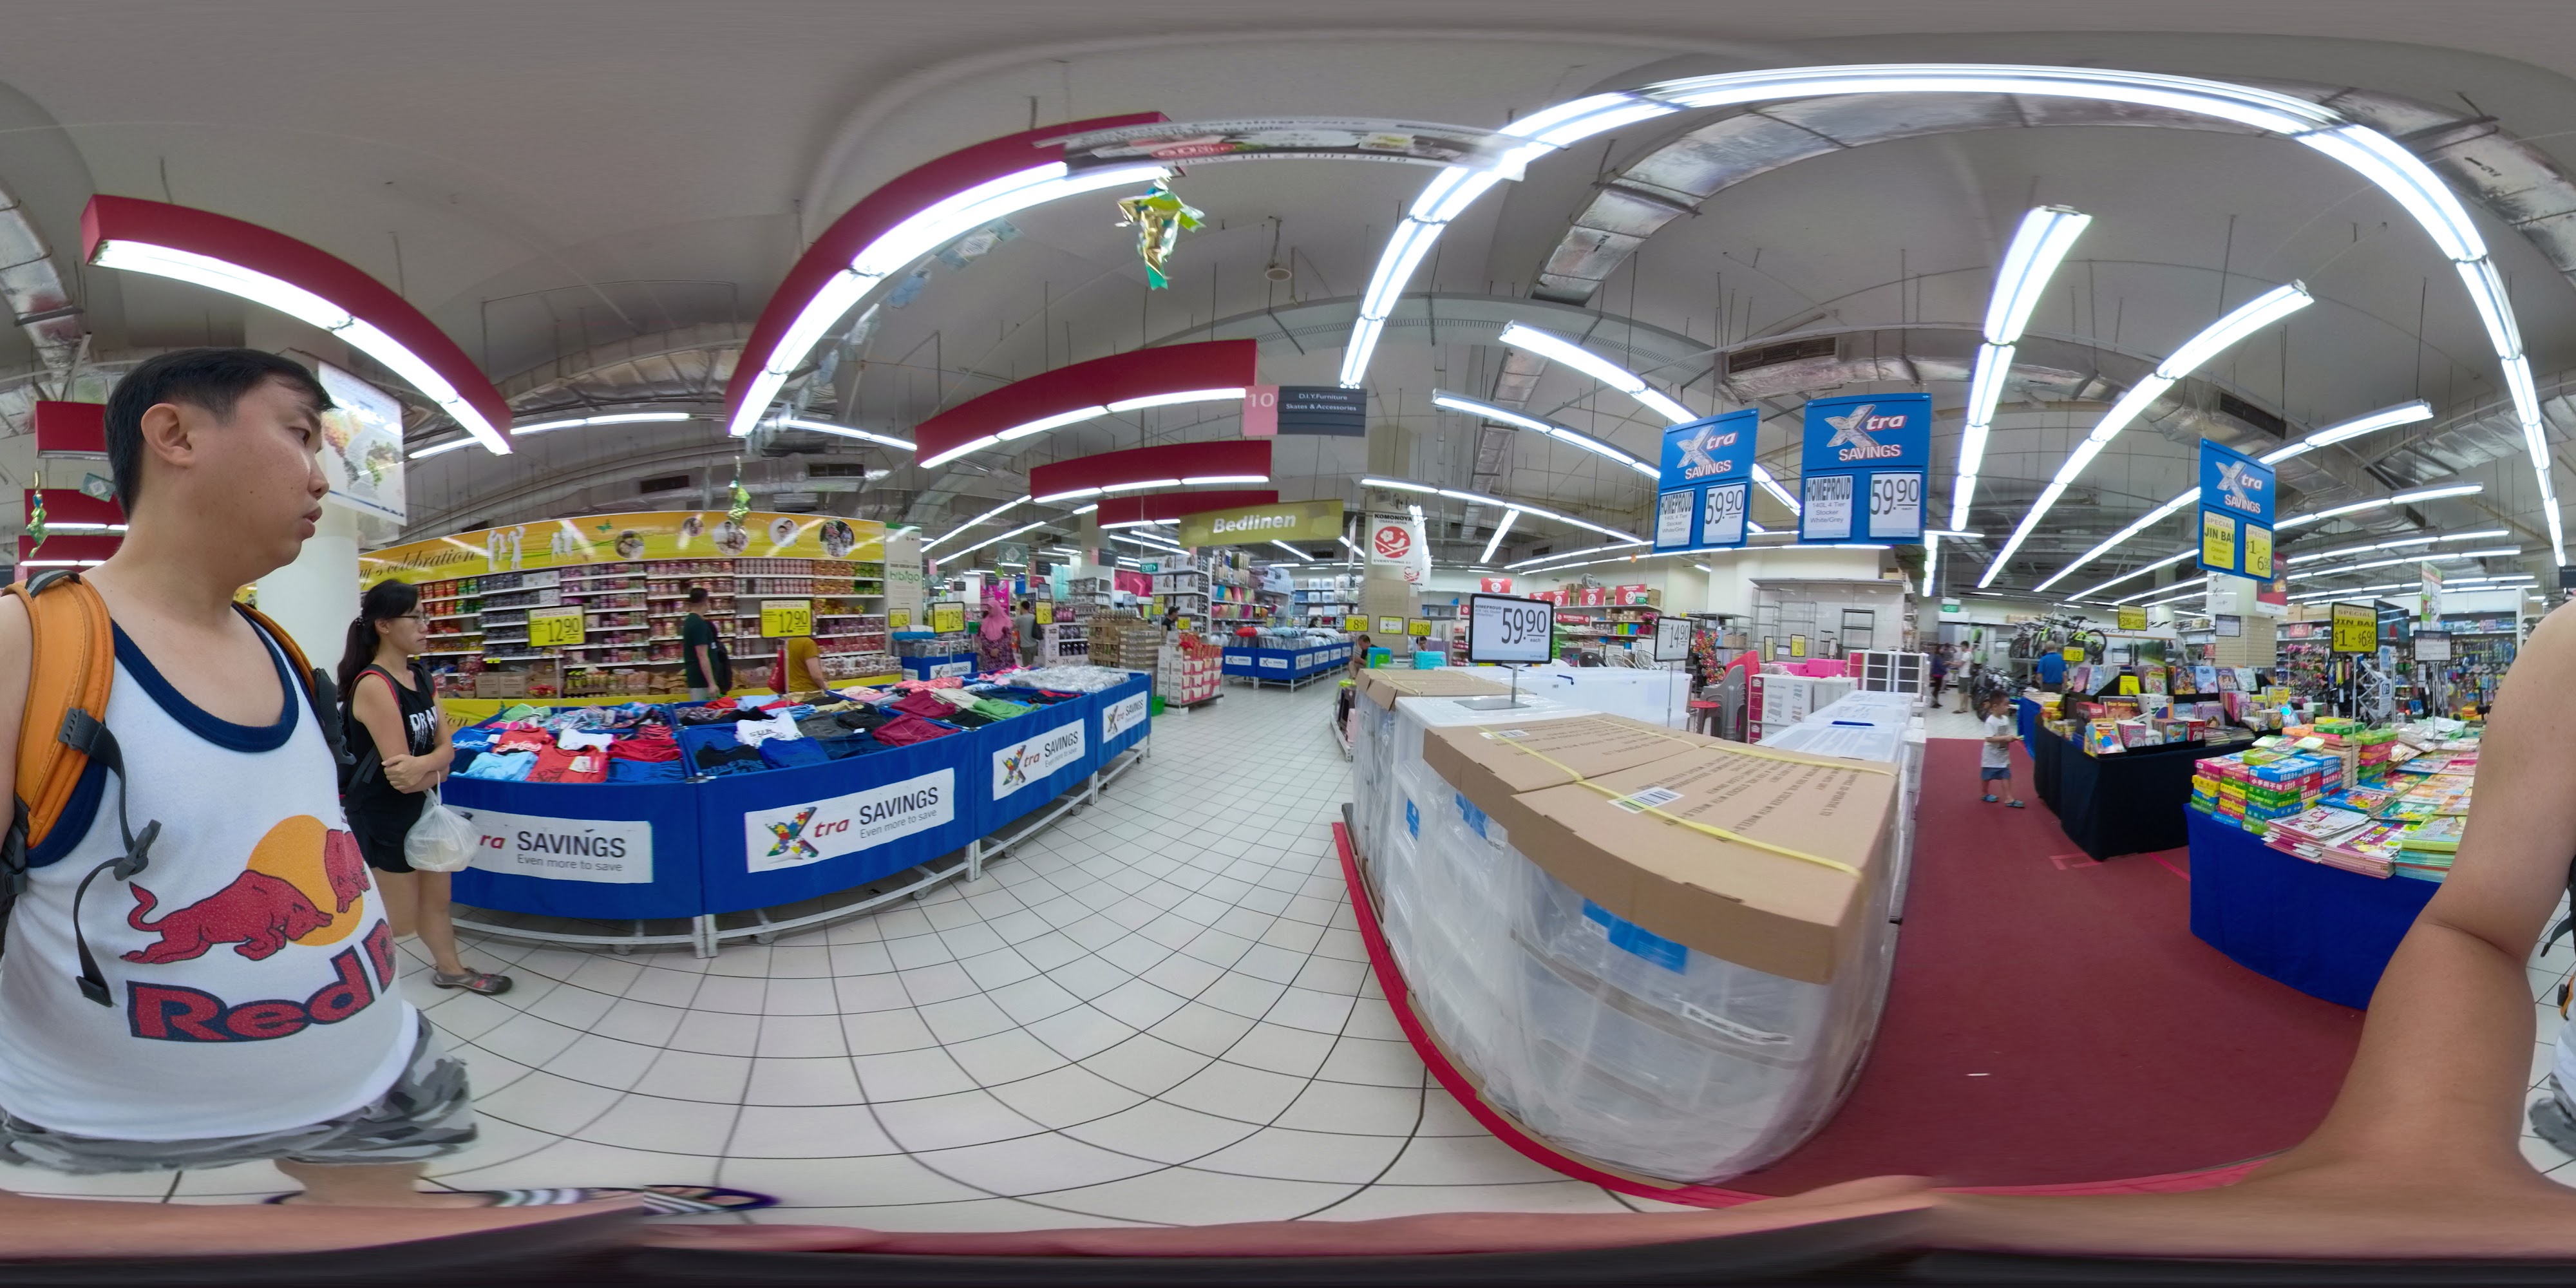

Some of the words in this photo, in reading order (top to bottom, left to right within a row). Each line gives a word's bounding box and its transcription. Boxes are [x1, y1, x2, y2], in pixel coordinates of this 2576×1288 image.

[1249, 393, 1274, 407] 10
[1825, 404, 1906, 448] Xtra
[1676, 426, 1738, 468] Xtra
[1839, 444, 1902, 462] SAVINGS
[1685, 460, 1731, 480] SAVINGS
[2215, 460, 2262, 500] Xtra
[1806, 477, 1850, 502] HOMEPROUD
[1870, 478, 1918, 515] 59.90
[1660, 492, 1692, 515] HOMEPROUD
[1705, 489, 1744, 525] 59.90
[2224, 494, 2260, 513] SAVINGS
[1213, 513, 1296, 533] Bedlinen
[2204, 527, 2218, 539] JIN
[2221, 531, 2234, 543] BAI
[2206, 517, 2233, 529] SPECIAL
[2248, 529, 2271, 540] SPECIAL
[387, 549, 476, 574] celebration
[889, 571, 920, 583] bibigo
[547, 618, 580, 643] 12.90
[779, 611, 808, 633] 12.90
[1501, 607, 1547, 645] 59.90
[1669, 624, 1689, 649] 14.90
[2334, 629, 2347, 647] $1
[1125, 699, 1144, 715] SAVINGS
[1001, 744, 1040, 786] Xtra
[1045, 731, 1078, 757] SAVINGS
[765, 806, 849, 858] Xtra
[859, 787, 938, 826] SAVINGS
[860, 825, 882, 838] Even
[884, 820, 905, 832] more
[907, 815, 916, 824] to
[918, 810, 936, 821] save
[517, 831, 626, 858] SAVINGS
[517, 855, 544, 866] Even
[547, 860, 577, 869] more
[580, 859, 592, 870] to
[595, 863, 623, 871] save
[126, 945, 375, 1043] Red
